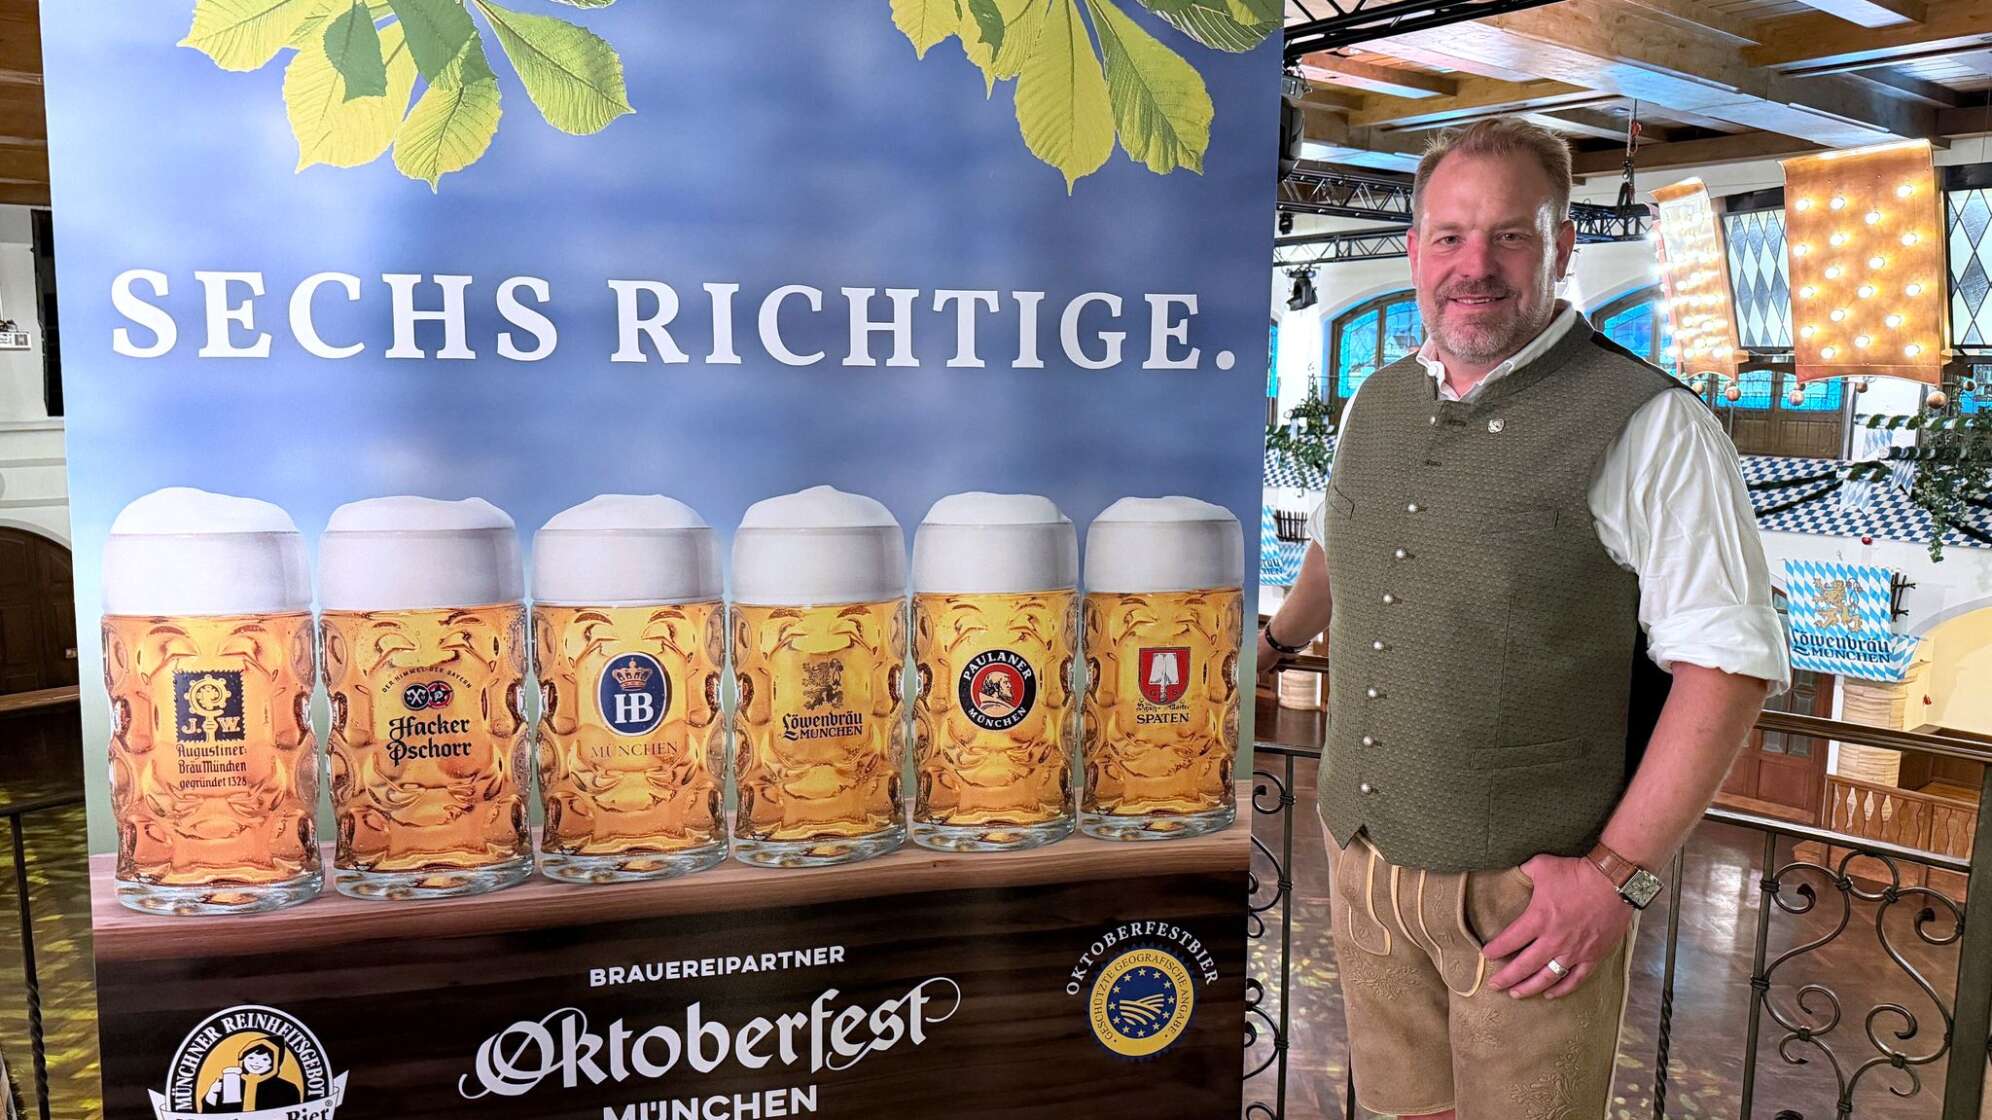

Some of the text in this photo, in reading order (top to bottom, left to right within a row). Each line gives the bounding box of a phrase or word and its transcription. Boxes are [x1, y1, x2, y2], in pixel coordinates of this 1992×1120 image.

[111, 269, 1237, 371] SECHS RICHTIGE.
[1792, 628, 1889, 656] Löwenbräu
[963, 652, 1032, 680] PAULANER
[614, 692, 654, 723] HB
[1136, 713, 1190, 724] SPATEN
[389, 714, 470, 740] Hacker
[782, 711, 863, 740] Löwenbräu
[386, 737, 472, 767] Pschorr
[591, 742, 678, 758] MÜNCHEN
[180, 777, 226, 791] gegründet
[589, 945, 845, 987] BRAUEREIPARTNER
[1066, 921, 1219, 996] OKTOBERFESTBIER
[1114, 953, 1187, 988] GEOGRAFISCHE
[1171, 988, 1188, 1034] ANGABE
[458, 976, 961, 1099] Oktoberfest
[171, 1012, 325, 1110] MÜNCHNER REINHEITSGEBOT
[603, 1085, 817, 1120] MÜNCHEN
